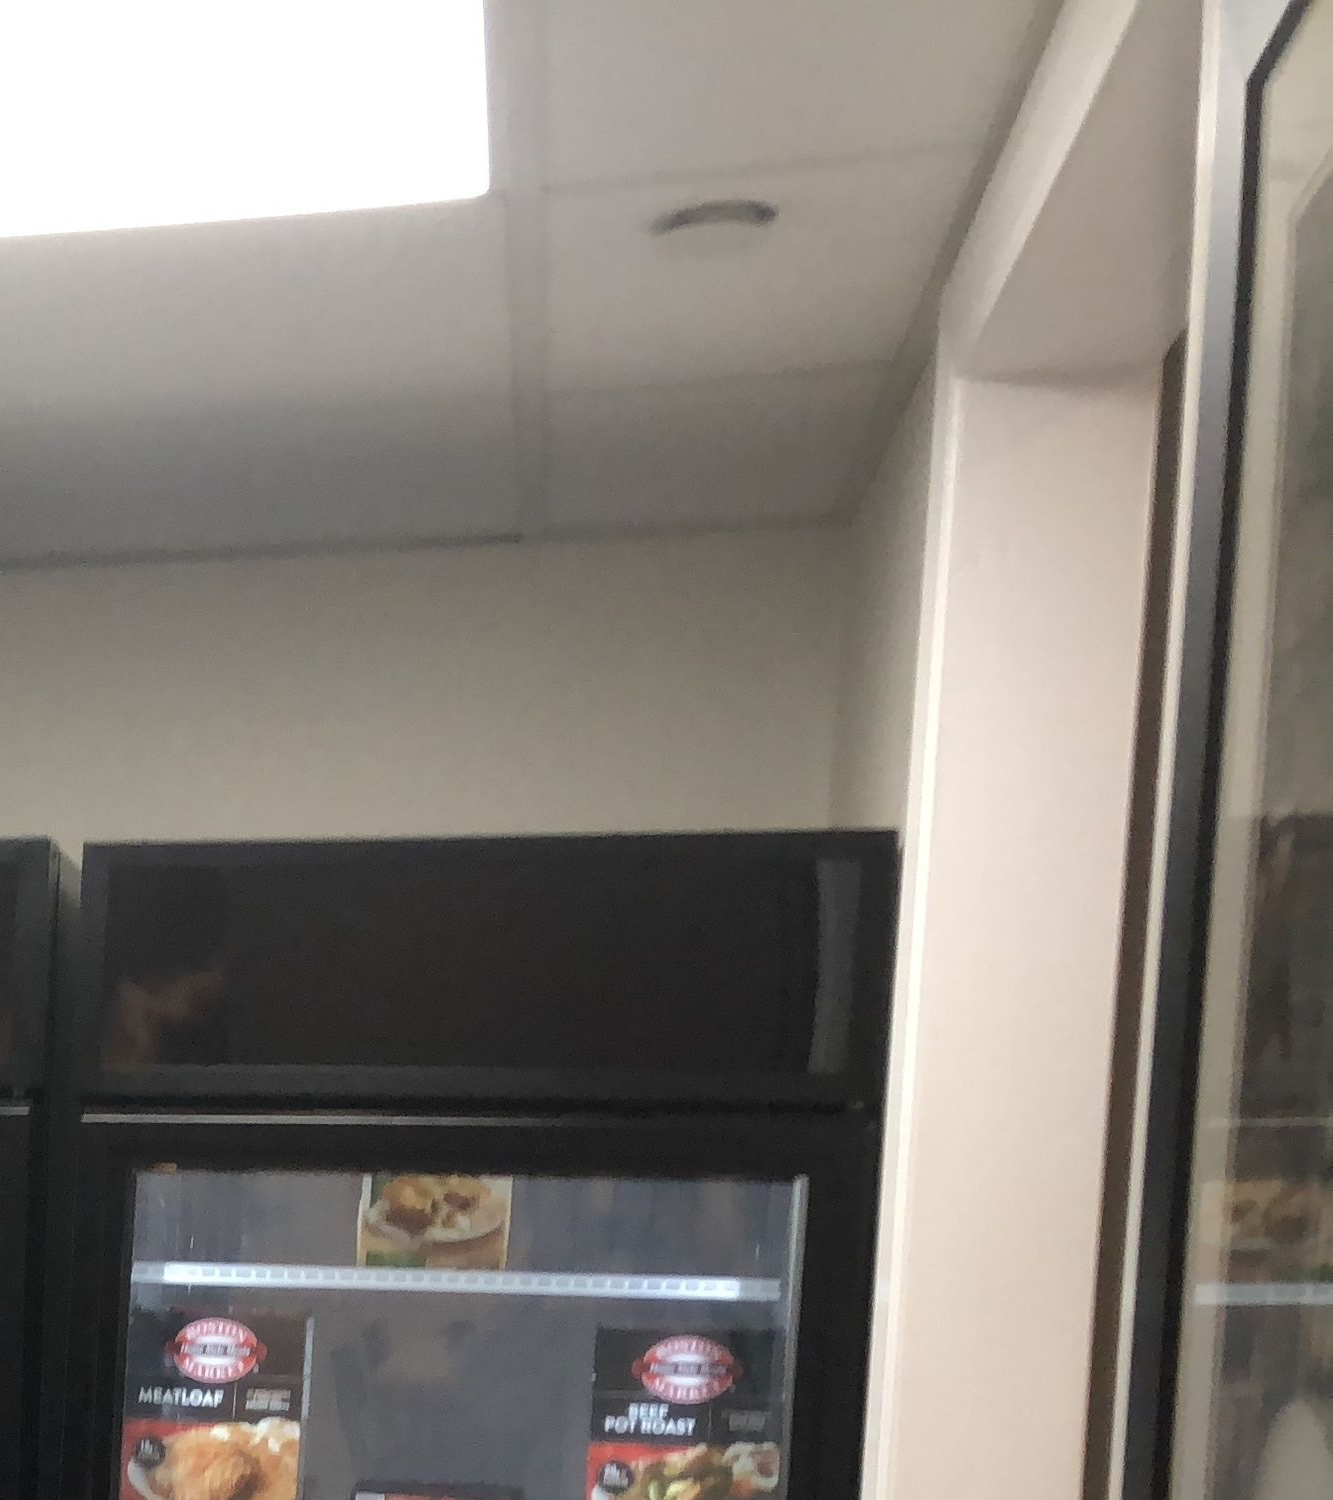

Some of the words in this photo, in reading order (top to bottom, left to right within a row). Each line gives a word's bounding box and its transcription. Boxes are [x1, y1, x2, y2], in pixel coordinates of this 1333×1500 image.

[137, 1384, 226, 1409] MEATLOAF
[628, 1401, 670, 1419] BEEF
[603, 1414, 636, 1435] POT
[640, 1415, 697, 1437] ROAST
